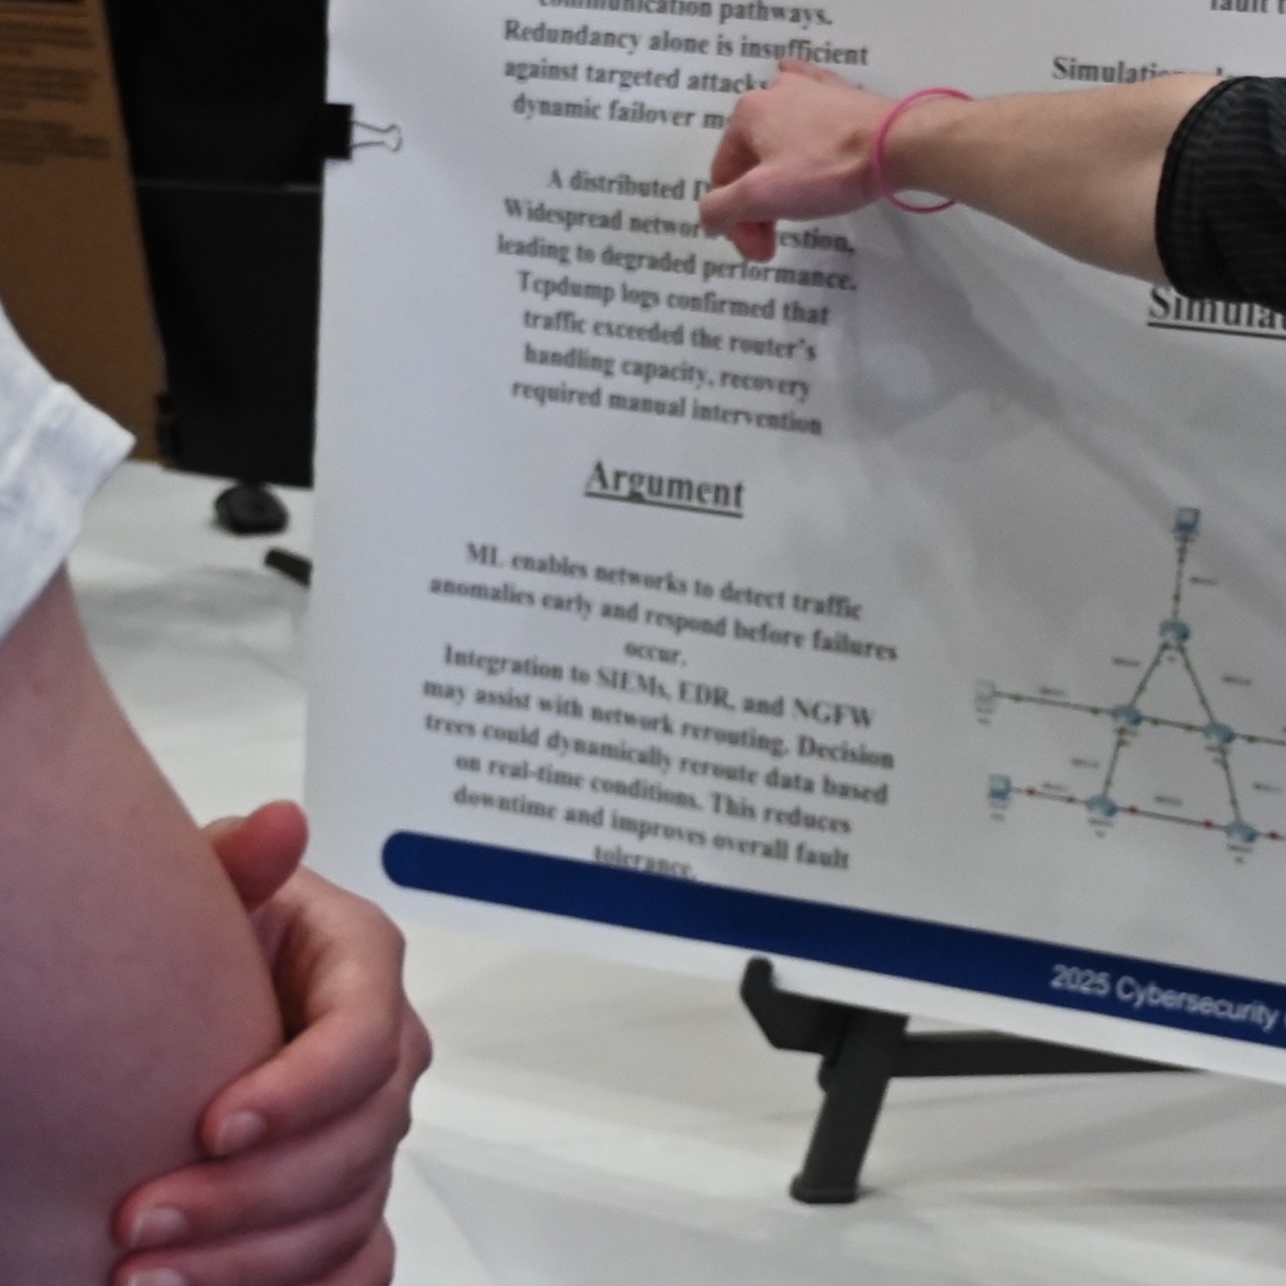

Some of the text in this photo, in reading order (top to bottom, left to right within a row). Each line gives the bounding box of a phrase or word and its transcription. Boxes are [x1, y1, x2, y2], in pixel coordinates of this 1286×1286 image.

[505, 20, 868, 66] Redundancy alone is insufficient
[719, 0, 833, 30] pathways.
[504, 60, 578, 84] against
[585, 64, 679, 92] targeted
[512, 94, 600, 121] dynamic
[608, 99, 695, 127] failover
[548, 169, 564, 189] A
[570, 170, 685, 201] distributed
[504, 198, 855, 255] Widespread networ estion,
[498, 234, 857, 292] leading to degraded performance.
[518, 270, 829, 325] Tcpdump logs confirmed that
[523, 309, 586, 332] traffic
[593, 319, 685, 345] exceeded
[691, 326, 722, 350] the
[524, 343, 615, 374] handling
[720, 370, 809, 401] recovery
[512, 379, 822, 435] required manual intervention
[587, 460, 745, 509] Argument
[466, 542, 862, 619] ML enables networks to detect traffic
[430, 575, 897, 661] anomalies early and respond before failures
[624, 640, 687, 666] occur.
[445, 644, 564, 682] Integration
[571, 664, 590, 684] to
[743, 695, 784, 717] and
[793, 698, 874, 728] NGFW
[424, 678, 466, 705] may
[475, 685, 531, 710] assist
[538, 693, 583, 718] with
[591, 704, 674, 735] network
[798, 734, 895, 770] Decision
[425, 713, 887, 805] trees could dynamically reroute data based
[455, 753, 481, 773] on
[488, 755, 583, 789] real-time
[711, 790, 756, 819] This
[763, 801, 852, 835] reduces
[453, 786, 850, 870] downtime and improves overall fault
[1050, 963, 1111, 997] 2025
[1116, 975, 1279, 1031] Cybersecurity
